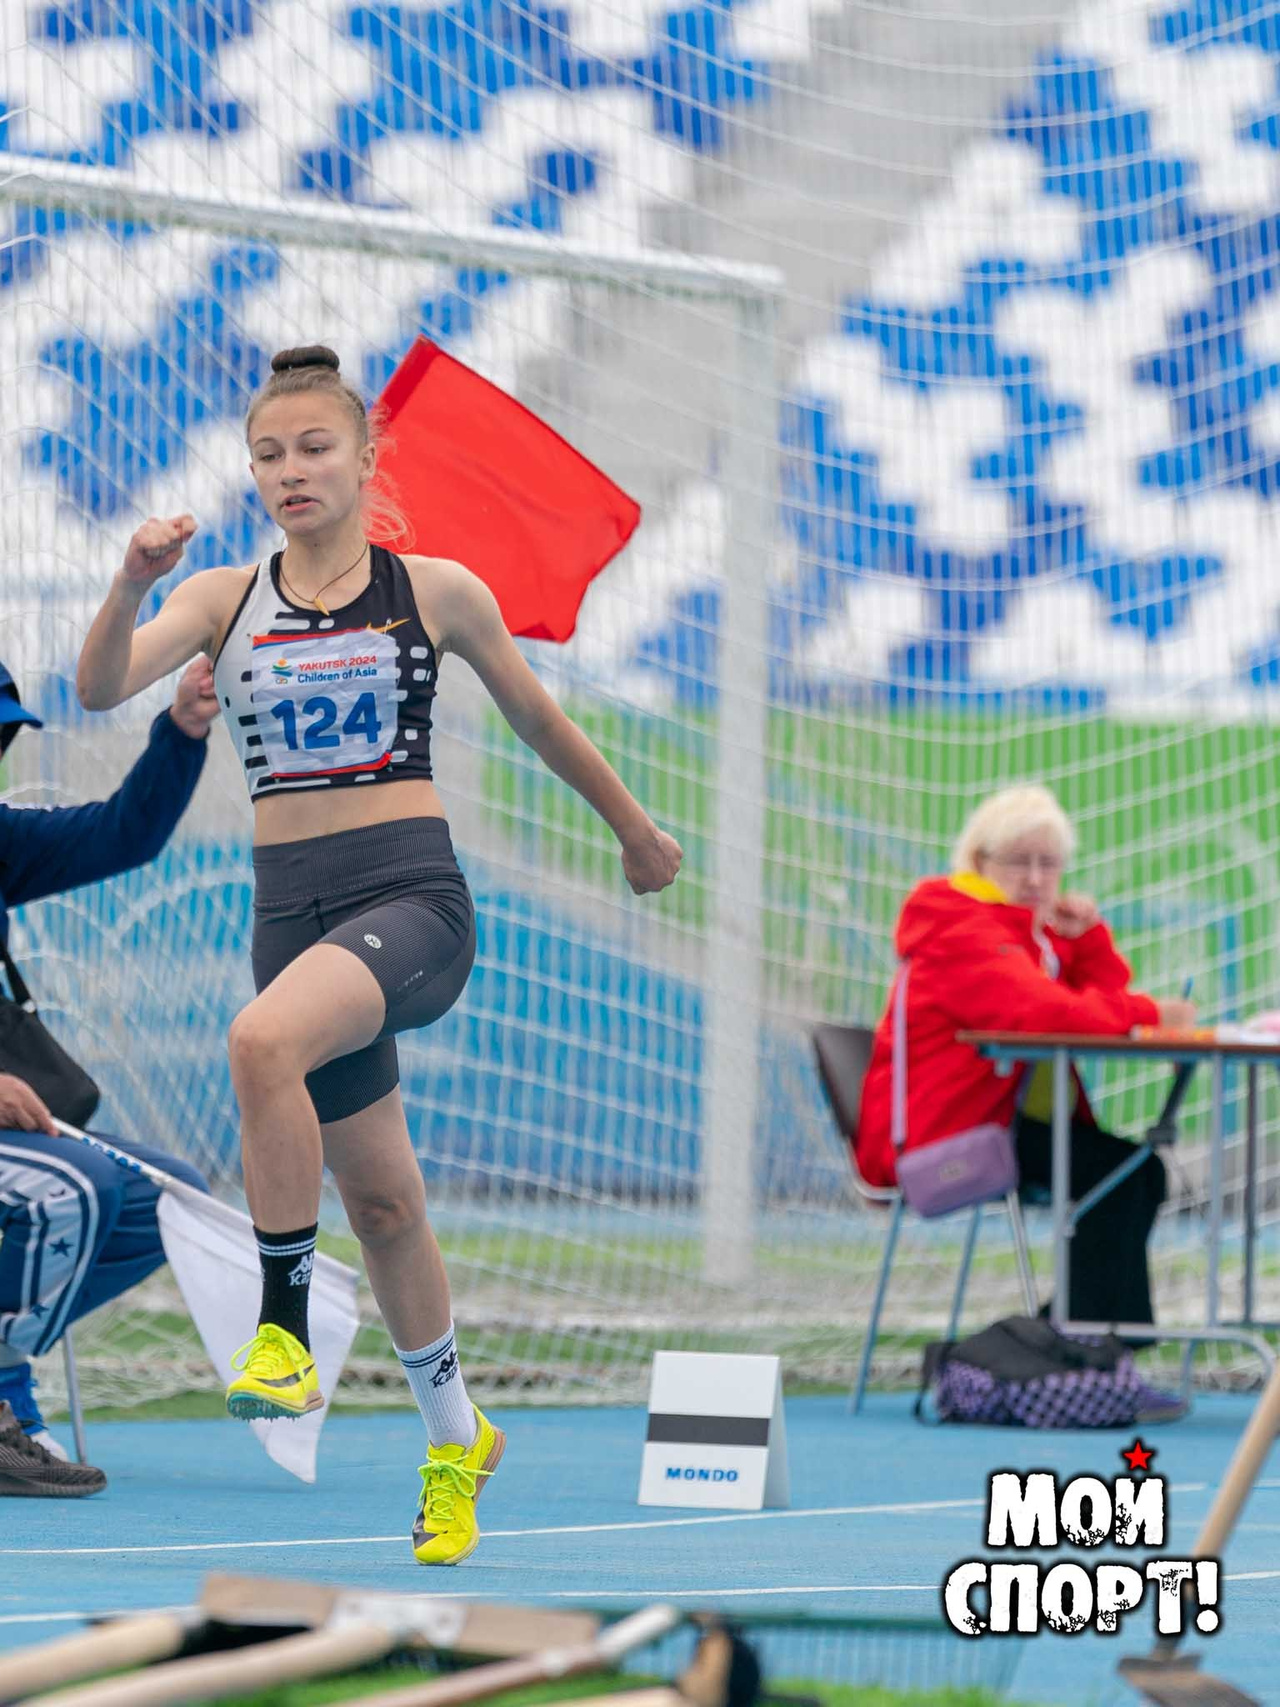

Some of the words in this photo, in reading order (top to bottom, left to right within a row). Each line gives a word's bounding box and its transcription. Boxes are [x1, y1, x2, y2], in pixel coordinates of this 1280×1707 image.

[298, 659, 347, 672] YAKUTSK
[348, 656, 378, 667] 2024
[297, 671, 340, 684] Children
[341, 669, 354, 680] of
[355, 667, 378, 678] Asia
[270, 691, 382, 751] 124
[665, 1466, 739, 1482] MONDO
